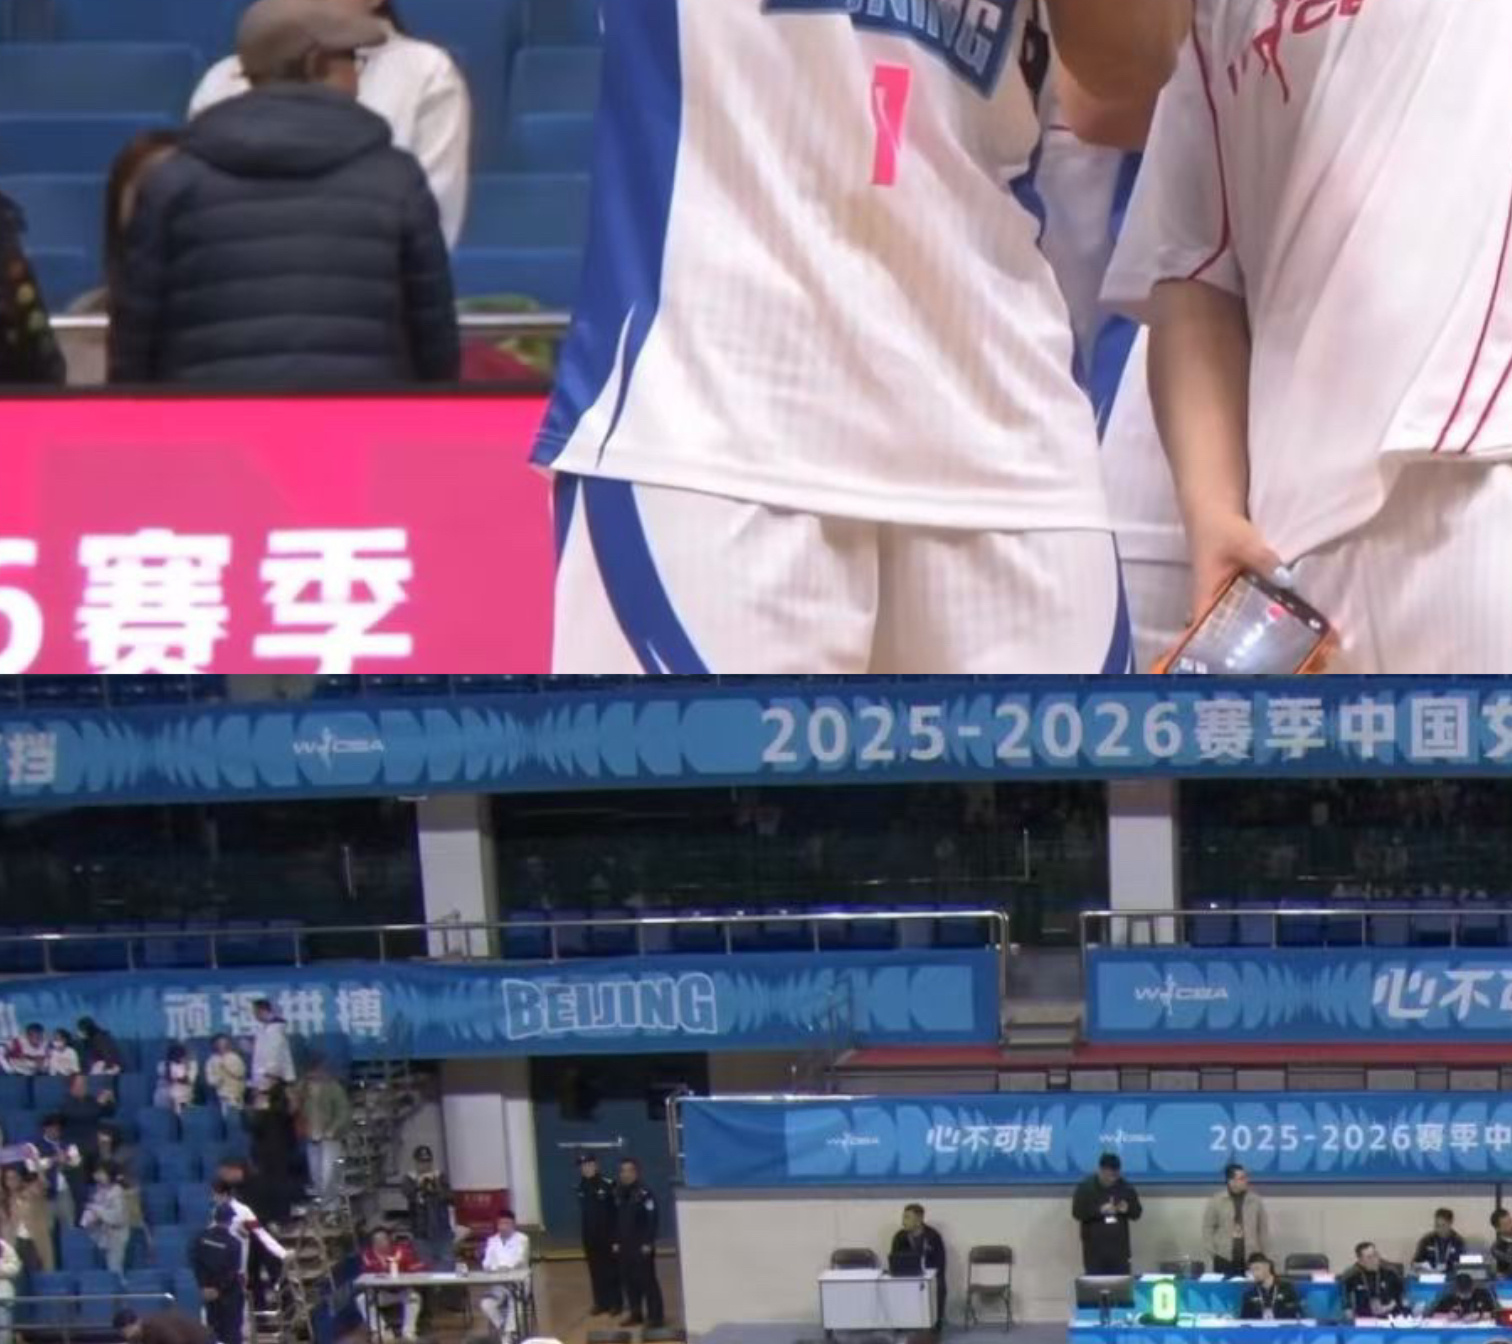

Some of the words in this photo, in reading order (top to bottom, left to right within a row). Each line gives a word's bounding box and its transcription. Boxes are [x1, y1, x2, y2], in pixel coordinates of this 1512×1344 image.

[507, 978, 719, 1041] BEIJING
[926, 1125, 1053, 1154] 心不可挡
